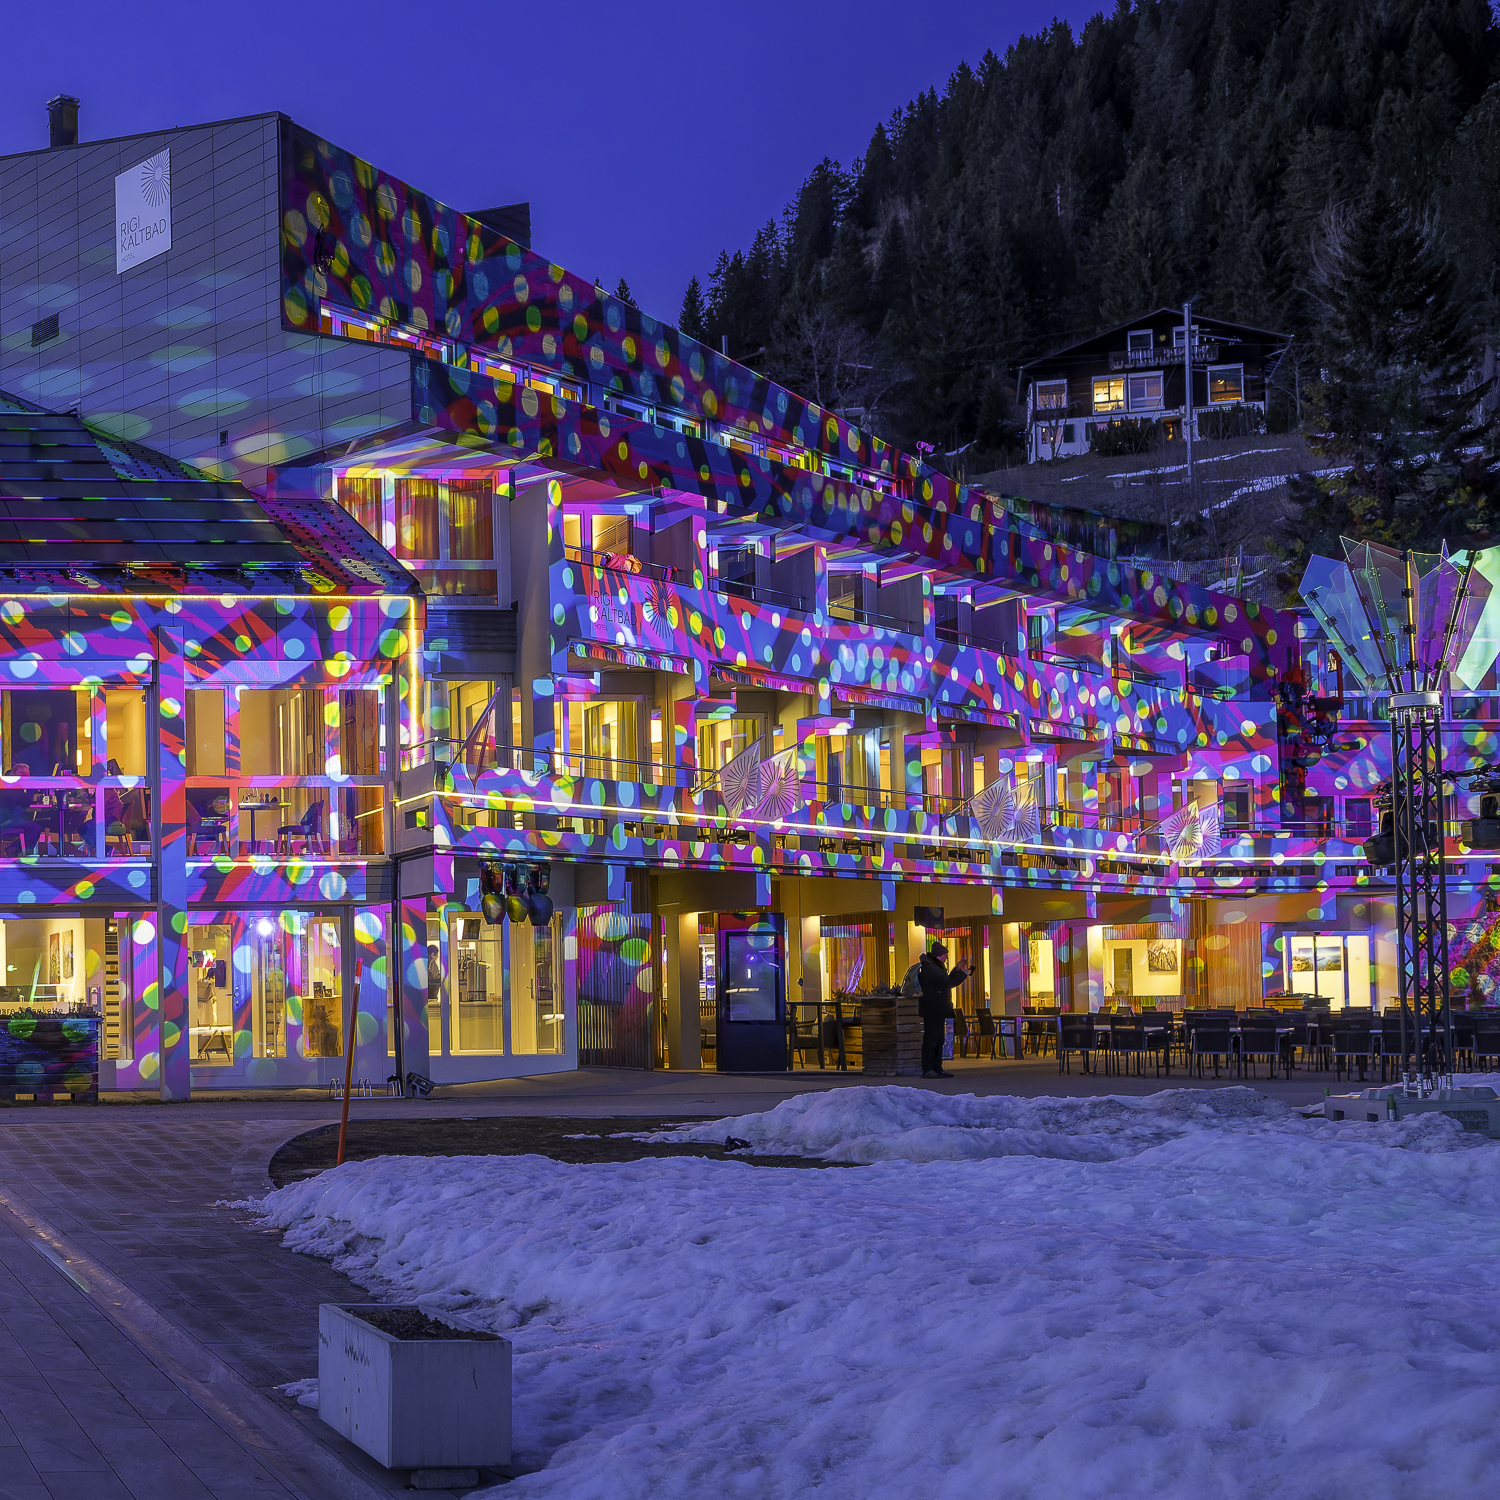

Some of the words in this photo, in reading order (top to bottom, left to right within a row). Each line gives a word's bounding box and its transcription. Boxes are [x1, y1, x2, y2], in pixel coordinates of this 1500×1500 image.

[121, 215, 140, 237] RIGI
[121, 218, 167, 253] KALTBAD
[594, 590, 613, 607] RIGI
[594, 606, 637, 626] KALTBAD
[595, 623, 608, 631] HOTEL
